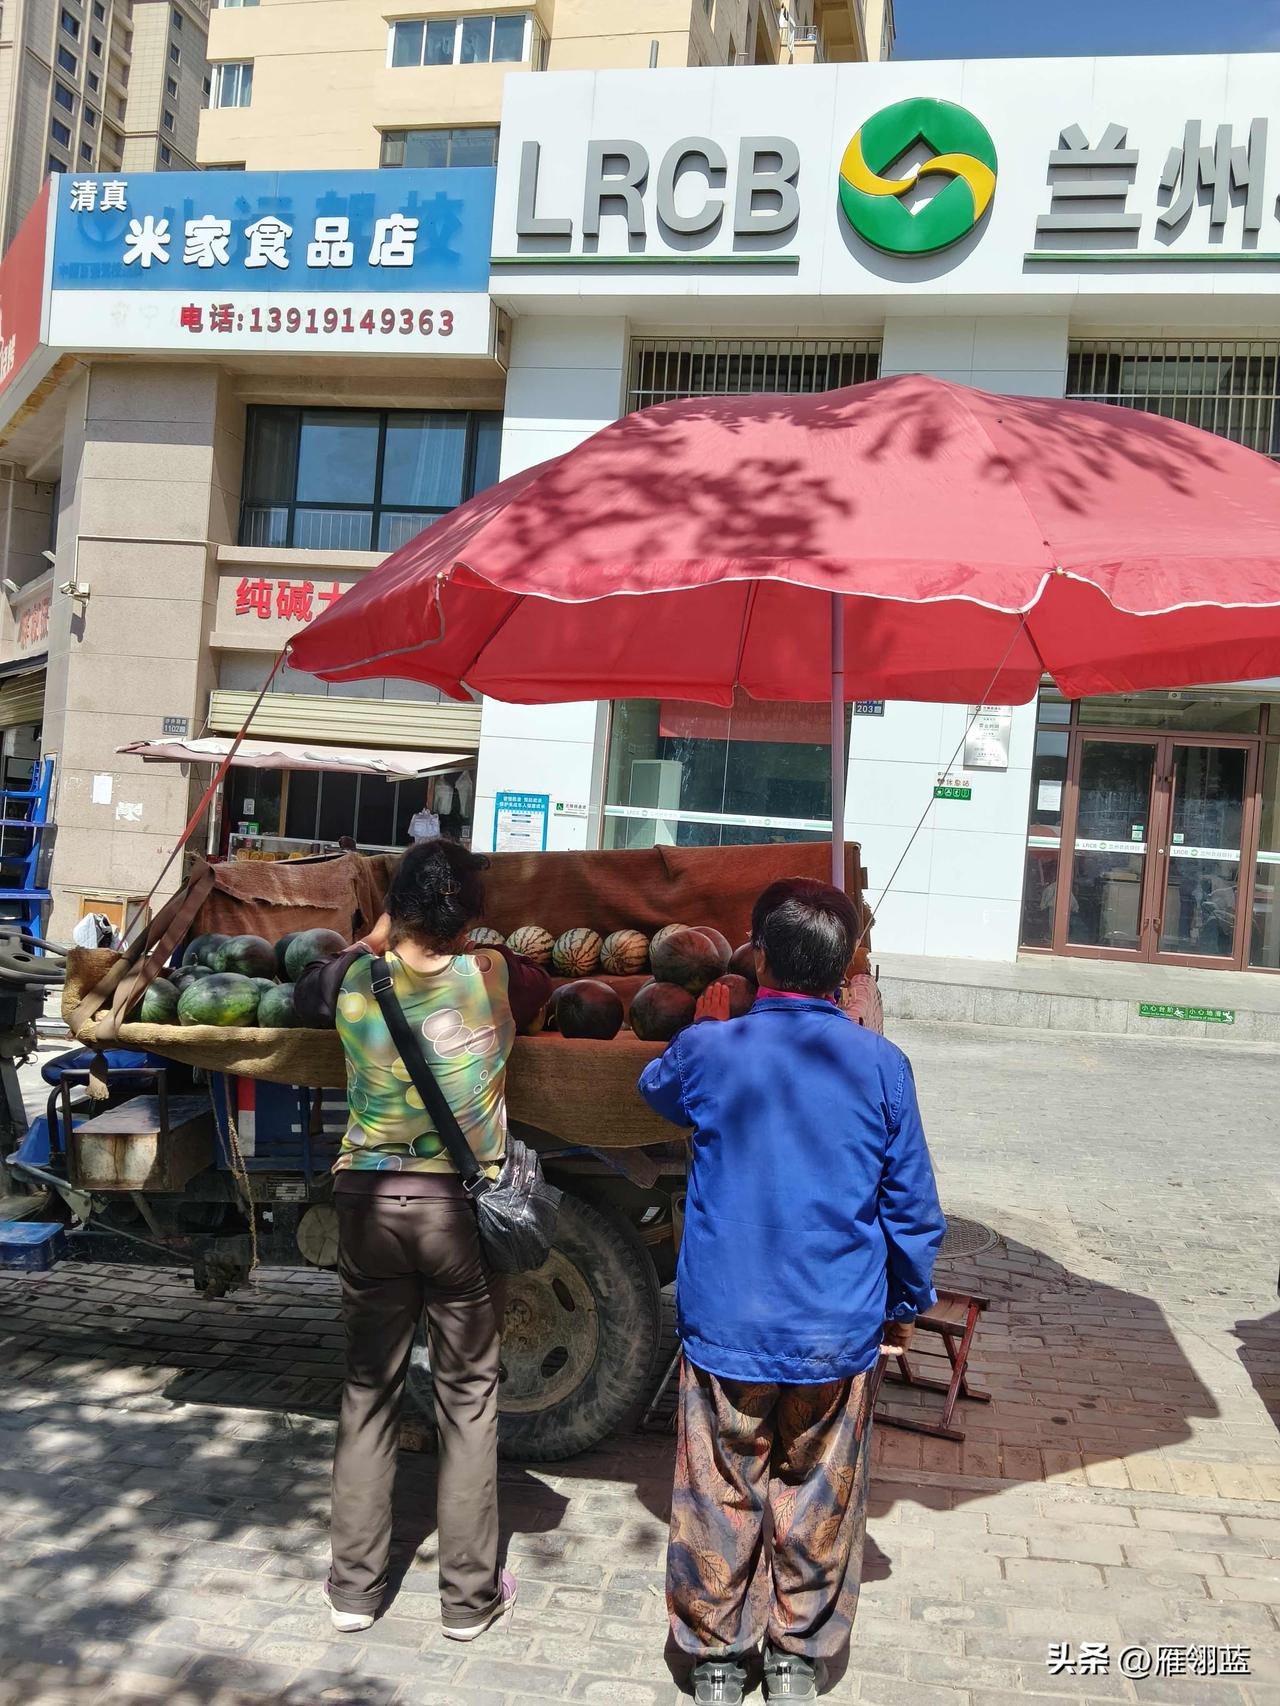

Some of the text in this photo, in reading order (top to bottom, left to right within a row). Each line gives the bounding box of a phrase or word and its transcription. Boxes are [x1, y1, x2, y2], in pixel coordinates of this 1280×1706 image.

[69, 180, 129, 213] 清真
[516, 135, 801, 237] LRCB
[1036, 117, 1280, 235] 兰州
[122, 213, 420, 269] 米家食品店
[179, 302, 455, 337] 电话:13919149363
